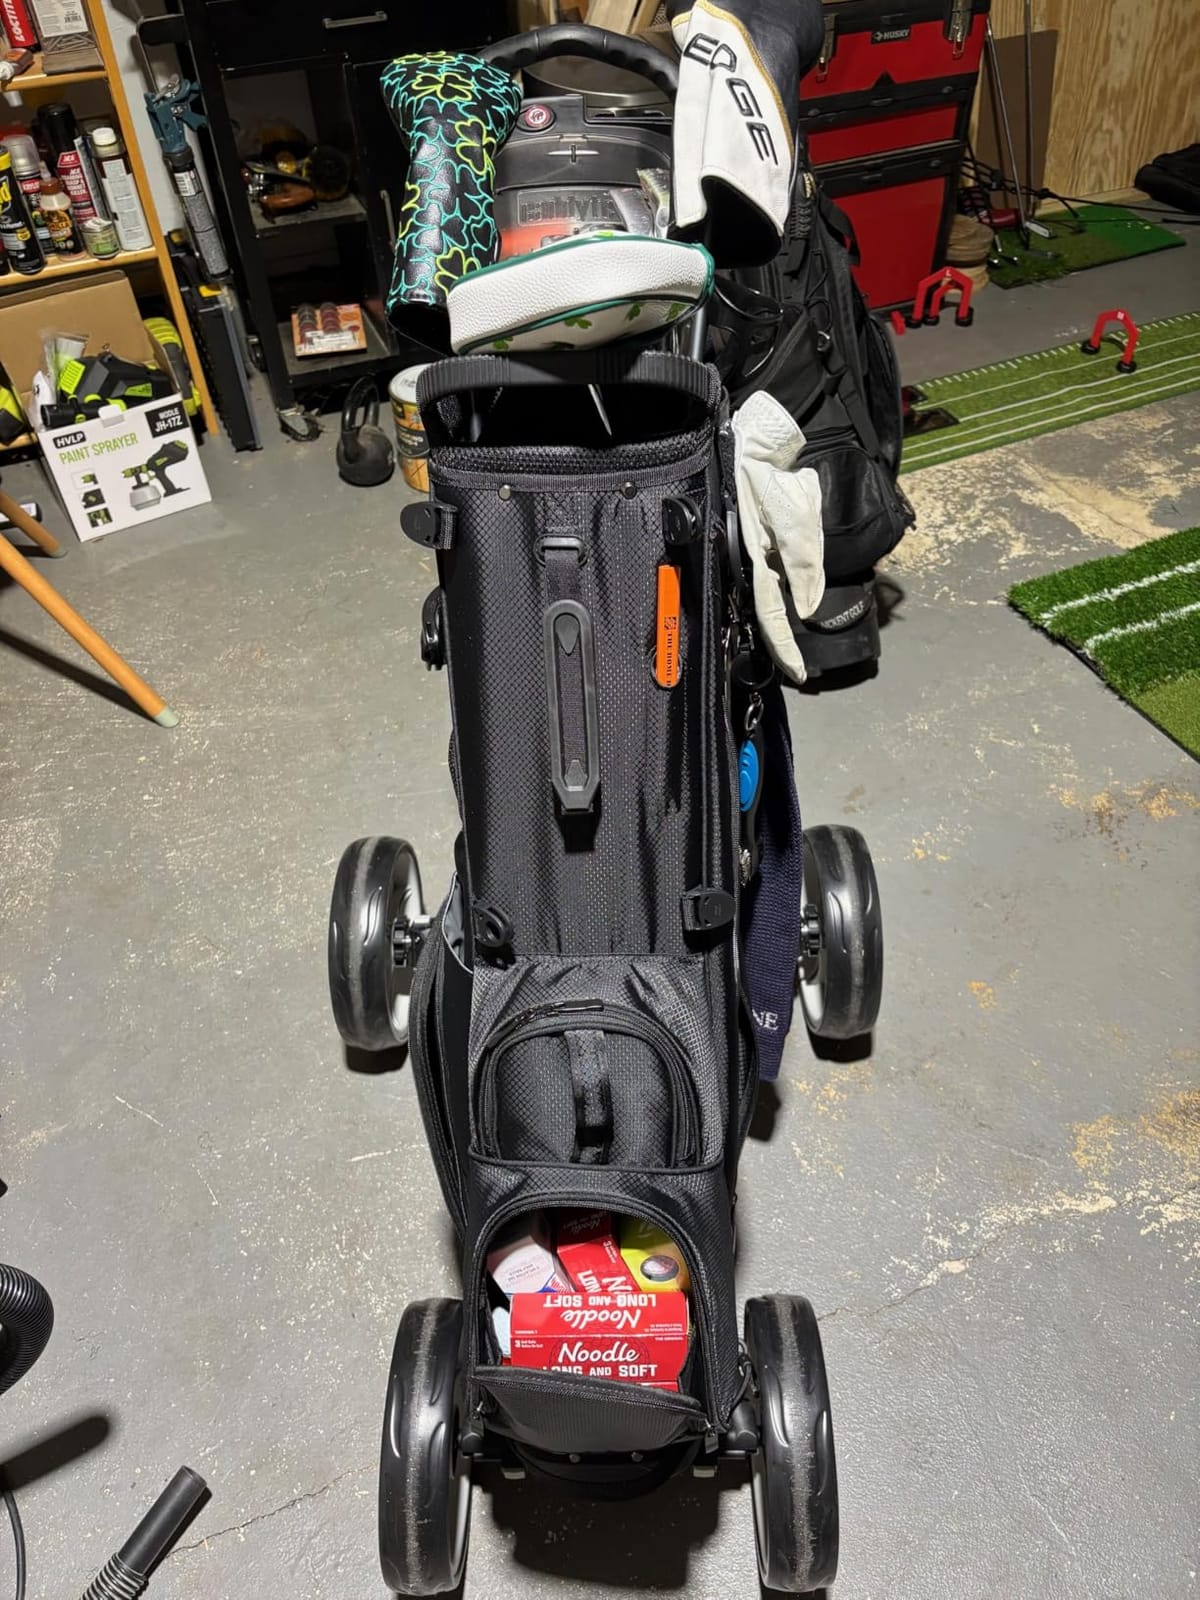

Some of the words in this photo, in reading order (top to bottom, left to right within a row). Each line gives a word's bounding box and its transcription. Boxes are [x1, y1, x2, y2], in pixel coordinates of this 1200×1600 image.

[883, 29, 910, 40] HUSKY
[683, 32, 778, 166] EDGE
[56, 433, 84, 448] HVLP
[59, 446, 90, 465] PAINT
[91, 432, 139, 456] SPRAYER
[849, 600, 865, 619] GOLF
[577, 1269, 602, 1293] LON
[542, 1294, 583, 1308] SOFT
[588, 1296, 611, 1306] AND
[616, 1293, 656, 1307] LONG
[560, 1309, 642, 1330] Noodle
[558, 1341, 640, 1363] Noodle
[542, 1365, 584, 1376] ONG
[589, 1367, 612, 1377] AND
[618, 1364, 658, 1378] SOFT
